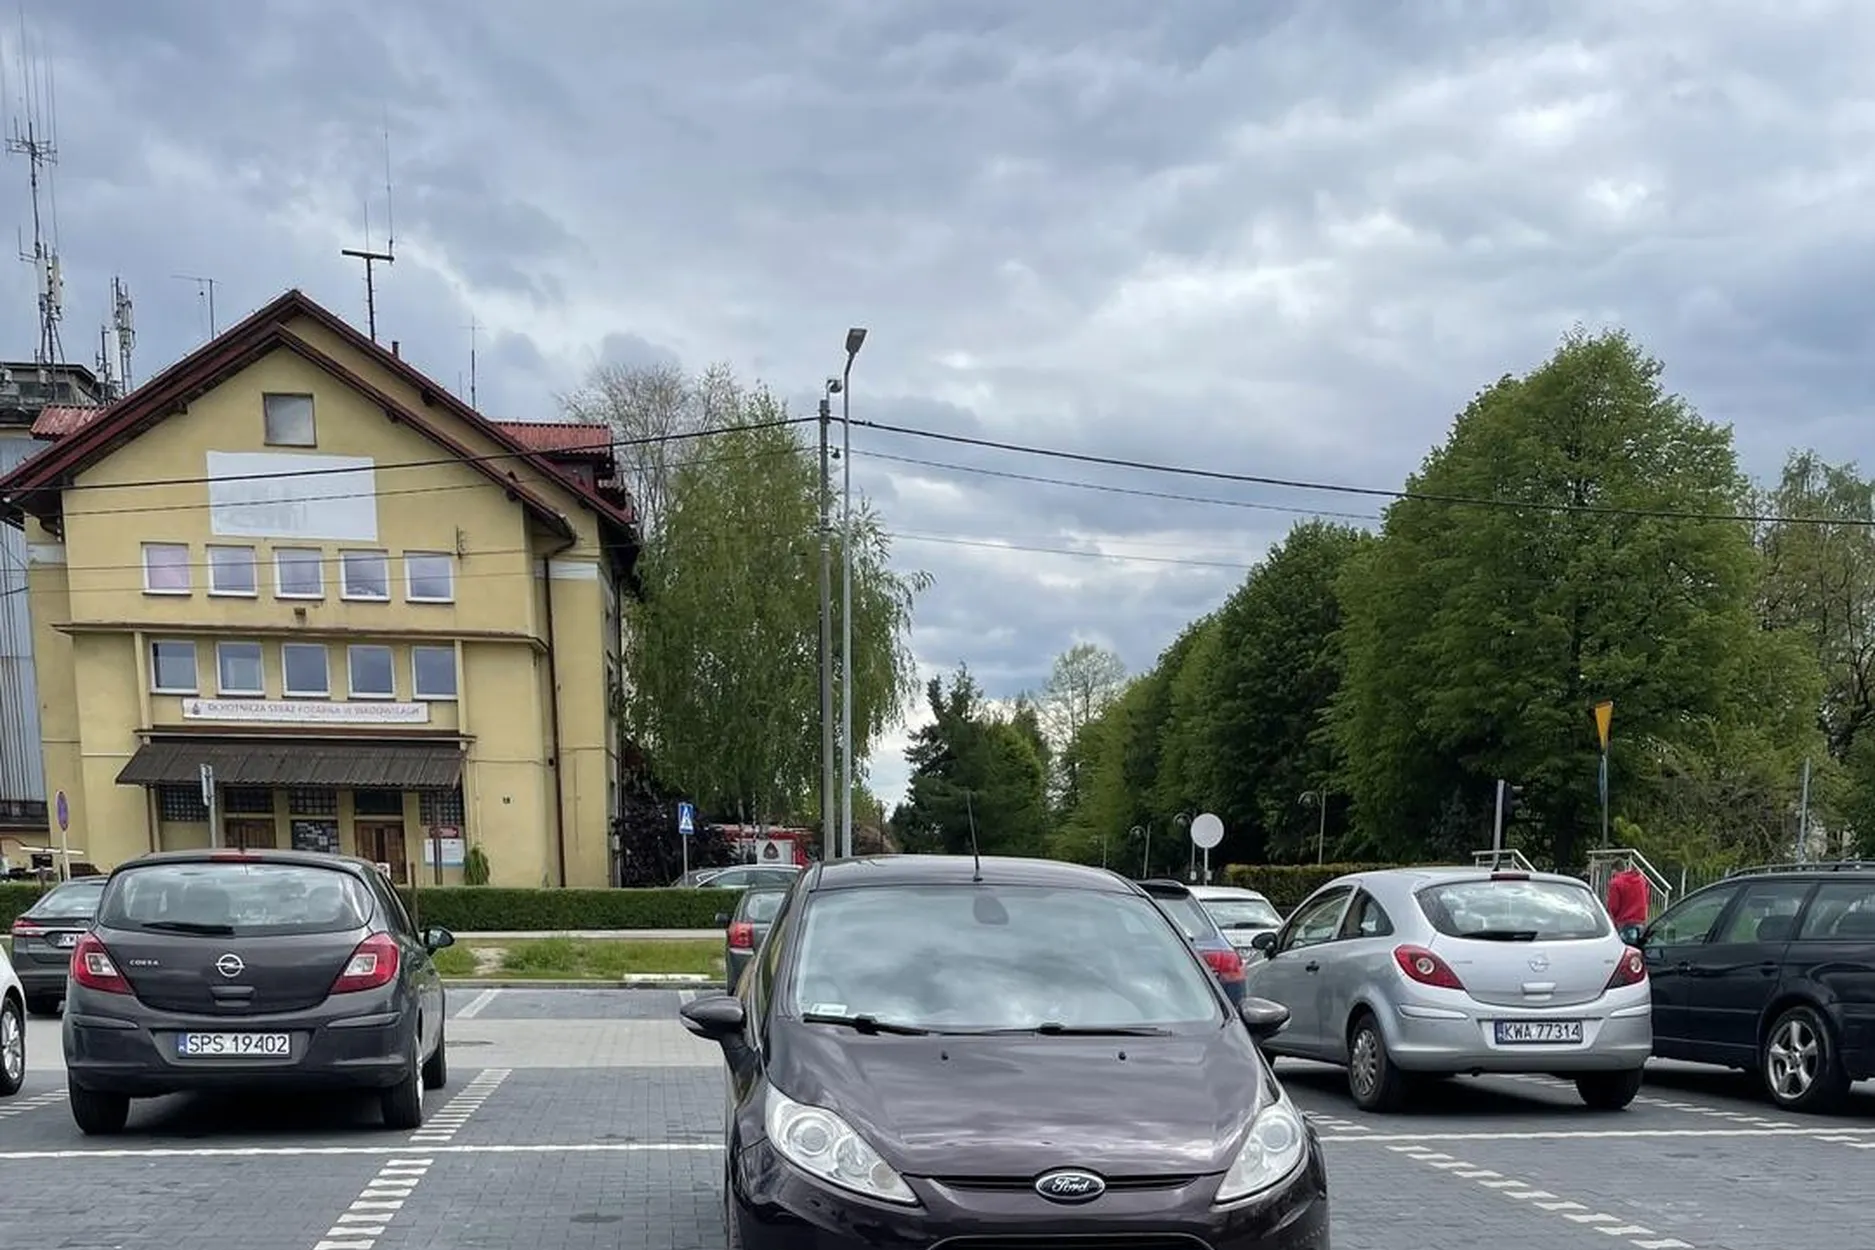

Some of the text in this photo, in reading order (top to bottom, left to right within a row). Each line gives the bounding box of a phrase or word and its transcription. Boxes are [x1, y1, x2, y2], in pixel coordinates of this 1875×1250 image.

[1504, 1023, 1532, 1039] KWA
[1536, 1023, 1580, 1039] 77314
[188, 1034, 225, 1052] SPS
[231, 1035, 287, 1052] 19402
[1051, 1176, 1090, 1192] Ford
